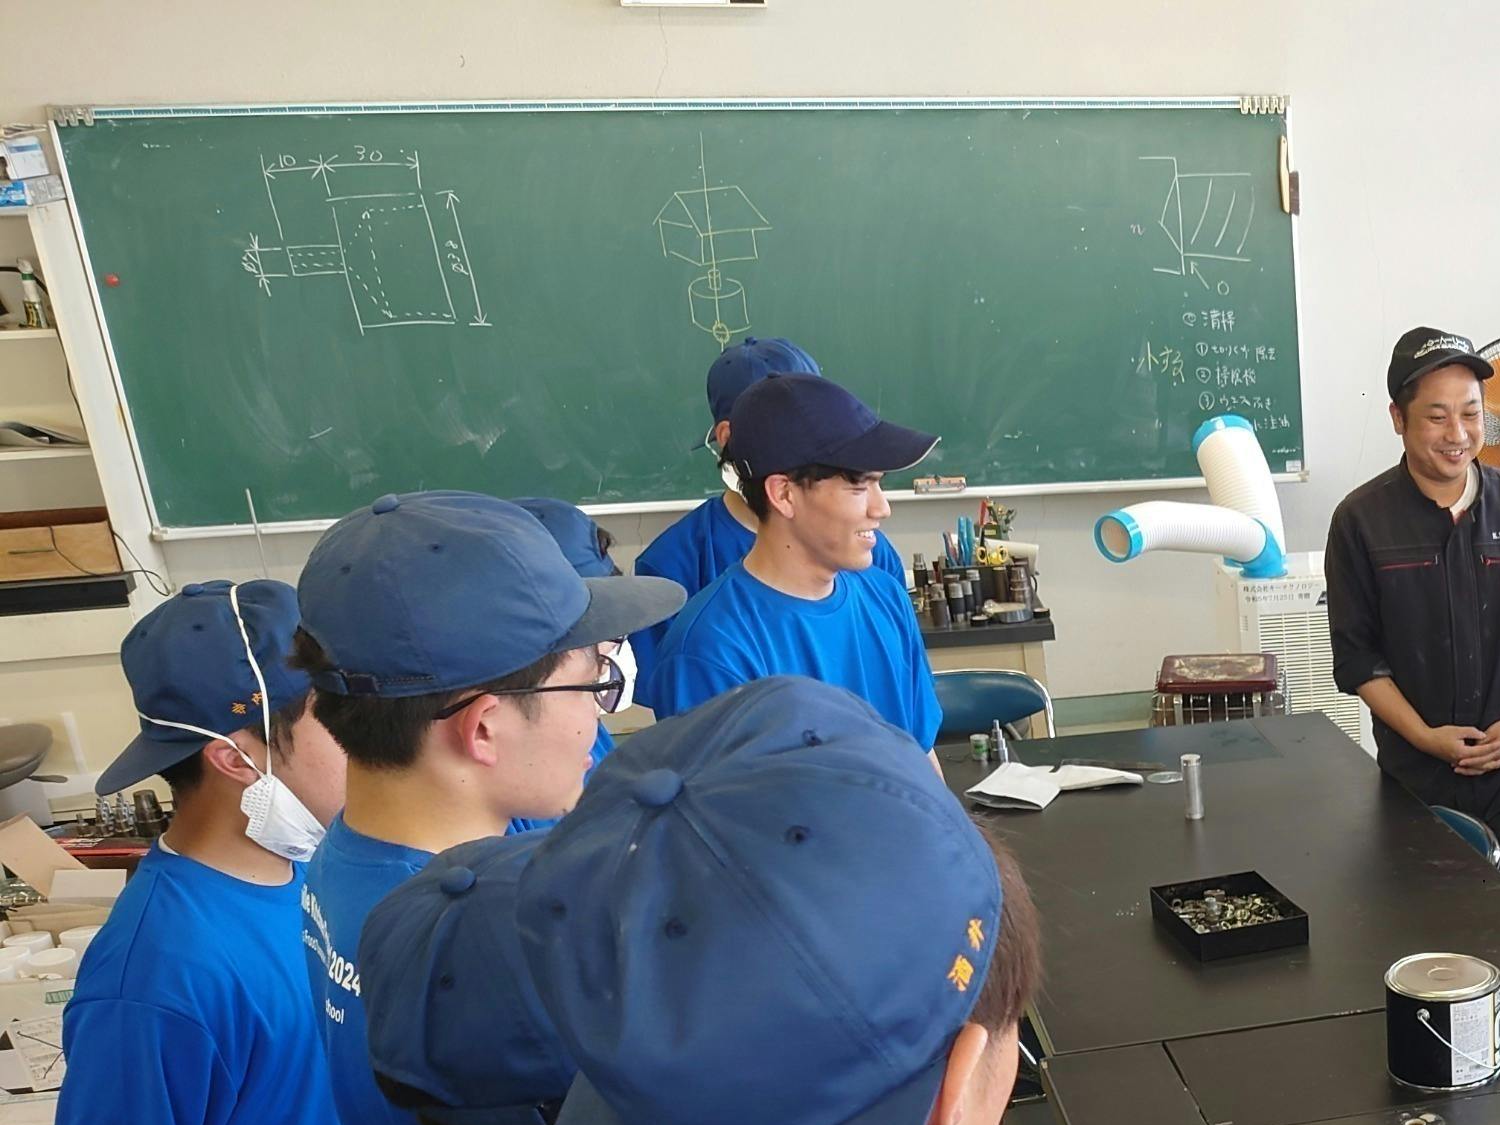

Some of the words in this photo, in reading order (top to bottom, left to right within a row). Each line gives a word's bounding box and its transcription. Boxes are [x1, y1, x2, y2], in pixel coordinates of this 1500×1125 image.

[279, 154, 296, 168] 10
[354, 145, 382, 162] 30
[328, 950, 362, 997] 2024
